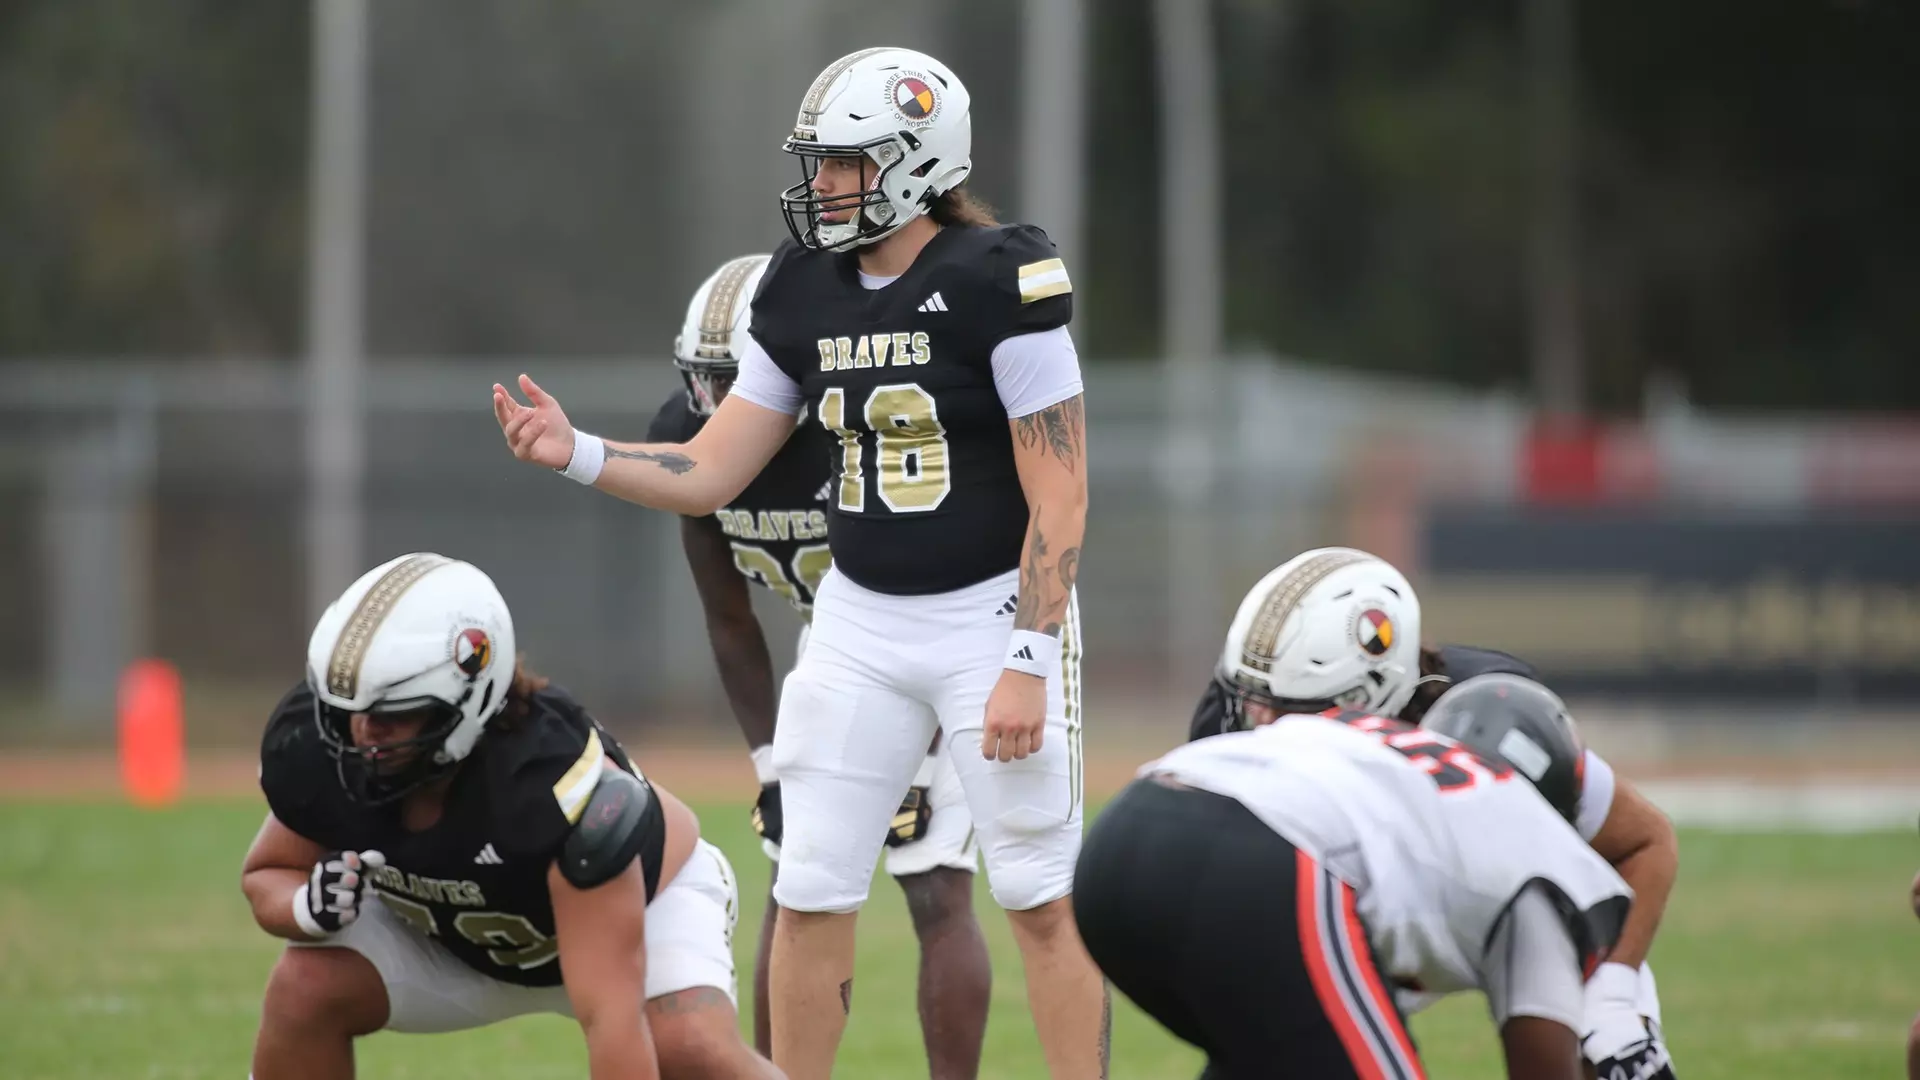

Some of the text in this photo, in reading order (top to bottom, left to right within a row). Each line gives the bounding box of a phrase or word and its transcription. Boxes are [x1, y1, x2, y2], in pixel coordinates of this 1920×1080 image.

[884, 71, 928, 105] LUMBEE TRIBE
[894, 112, 905, 122] OF
[904, 119, 930, 128] NORTH
[818, 331, 931, 372] BRAVES
[818, 383, 951, 513] 18
[715, 509, 828, 541] BRAVES
